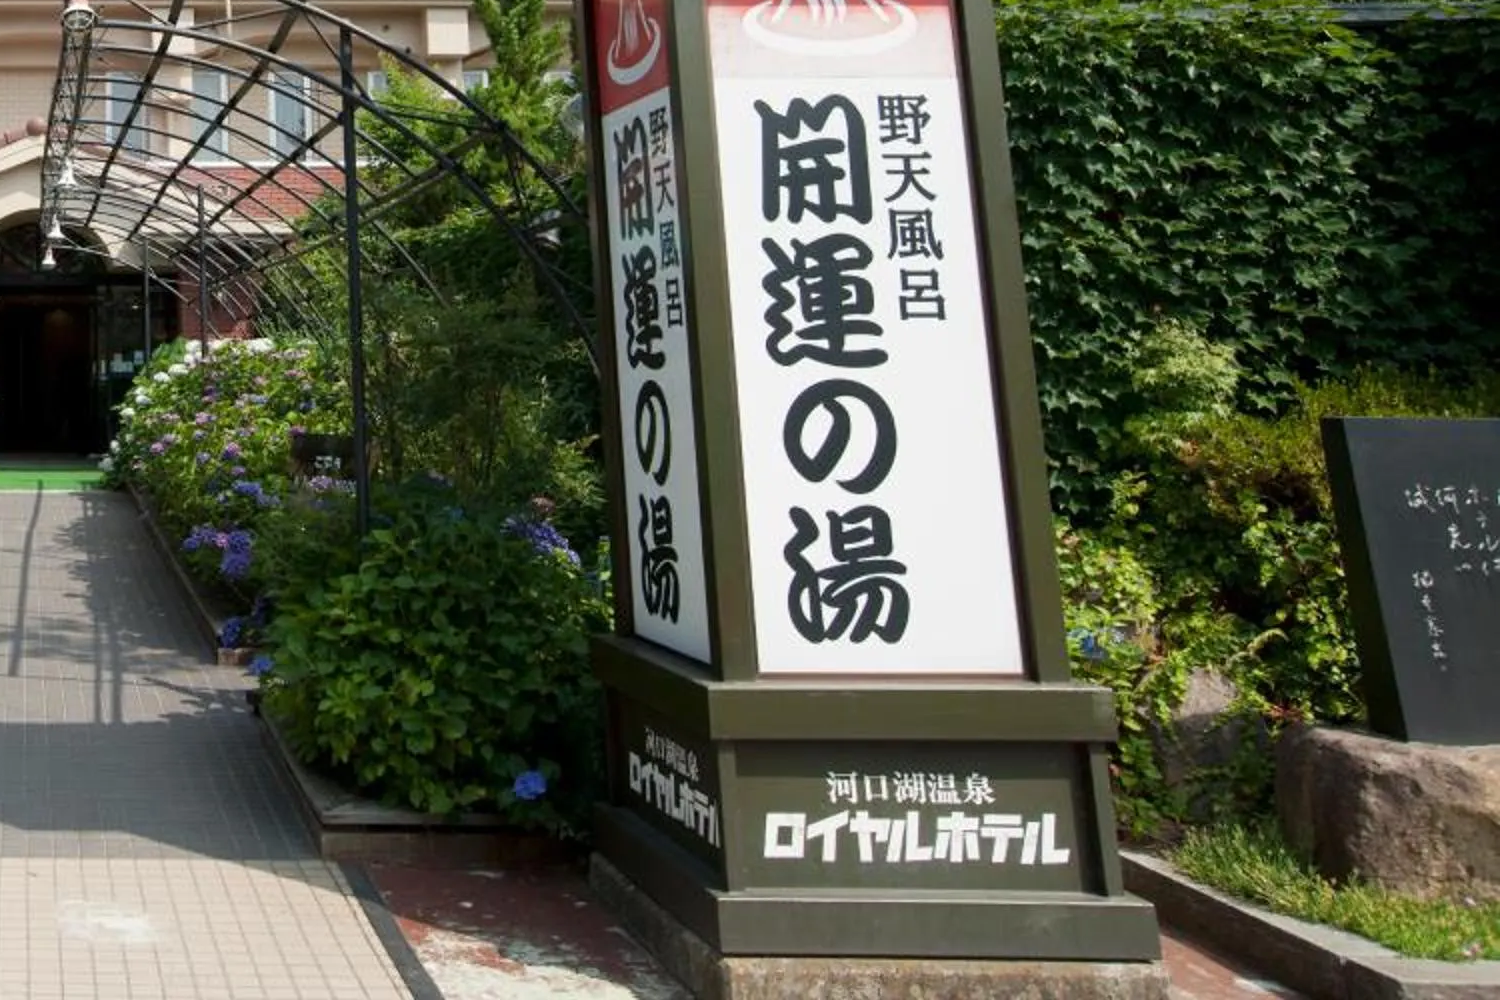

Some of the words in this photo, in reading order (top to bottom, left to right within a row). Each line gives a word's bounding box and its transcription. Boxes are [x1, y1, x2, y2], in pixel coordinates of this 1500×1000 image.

[648, 106, 684, 329] 野天風呂
[877, 94, 947, 322] 野天風呂
[613, 115, 681, 626] 開運の湯
[753, 93, 910, 643] 開運の湯
[763, 810, 1070, 865] ロイヤルホテル
[826, 771, 997, 804] 河口湖温泉
